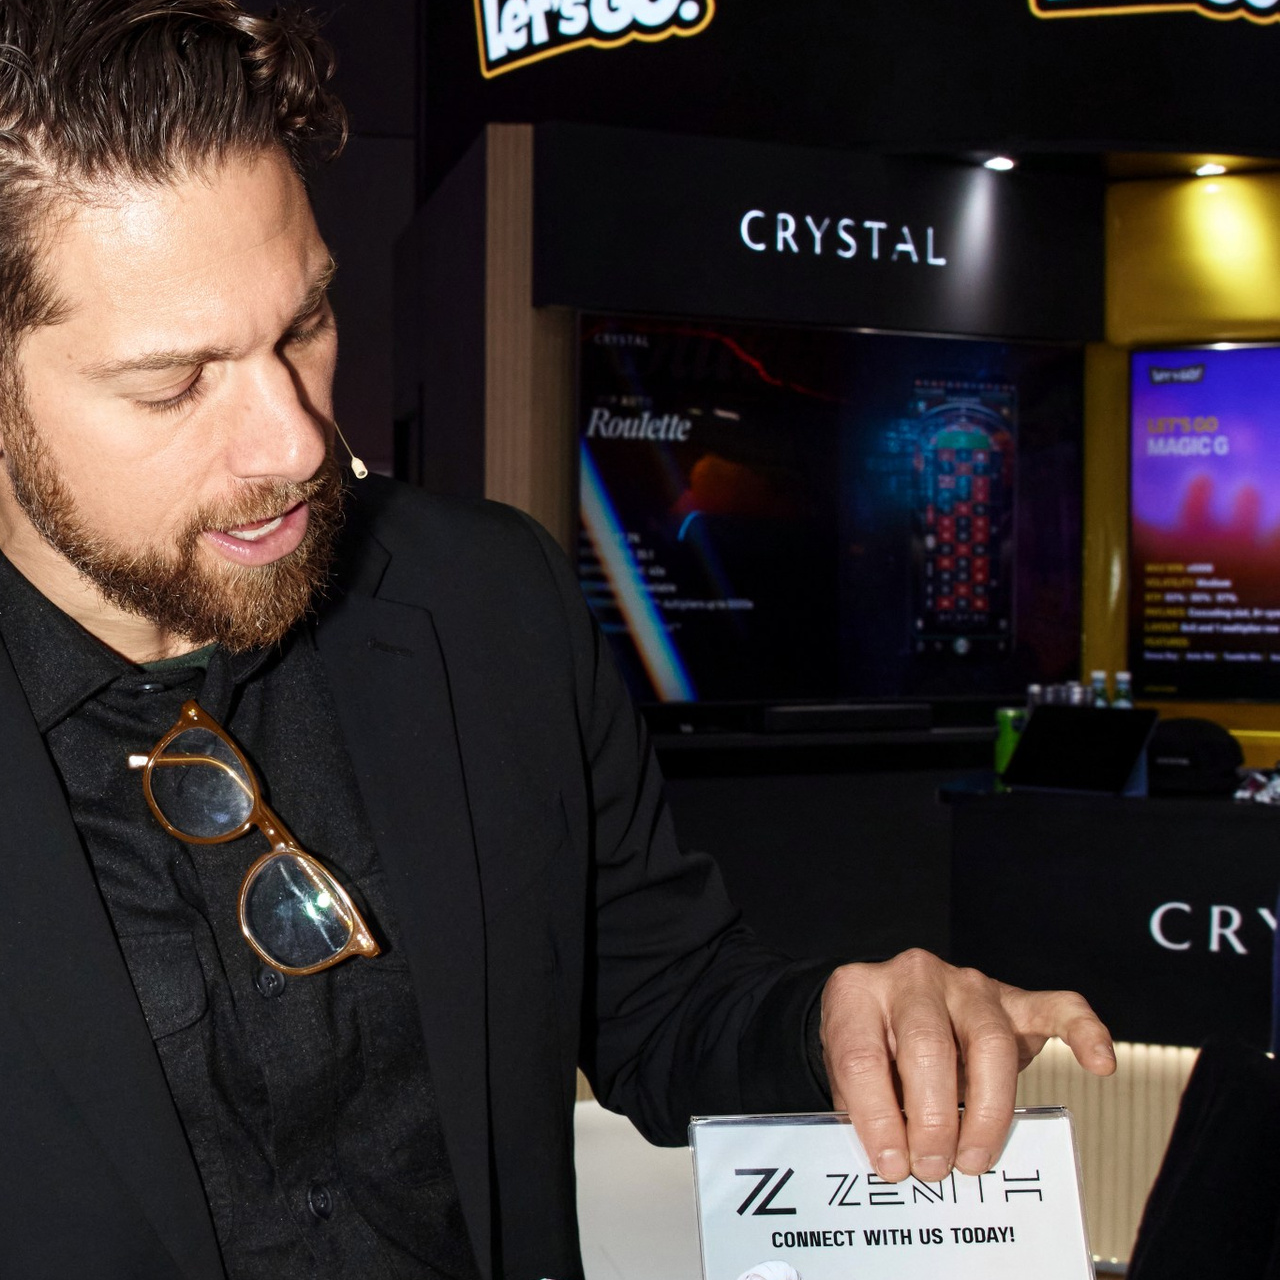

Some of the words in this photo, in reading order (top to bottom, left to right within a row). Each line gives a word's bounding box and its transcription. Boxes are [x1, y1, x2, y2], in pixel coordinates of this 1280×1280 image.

[740, 208, 948, 267] CRYSTAL
[586, 407, 693, 442] Roulette
[1147, 436, 1211, 456] MAGIC
[771, 1229, 856, 1249] CONNECT
[863, 1228, 913, 1247] WITH
[919, 1227, 944, 1246] US
[950, 1226, 1015, 1245] TODAY!
